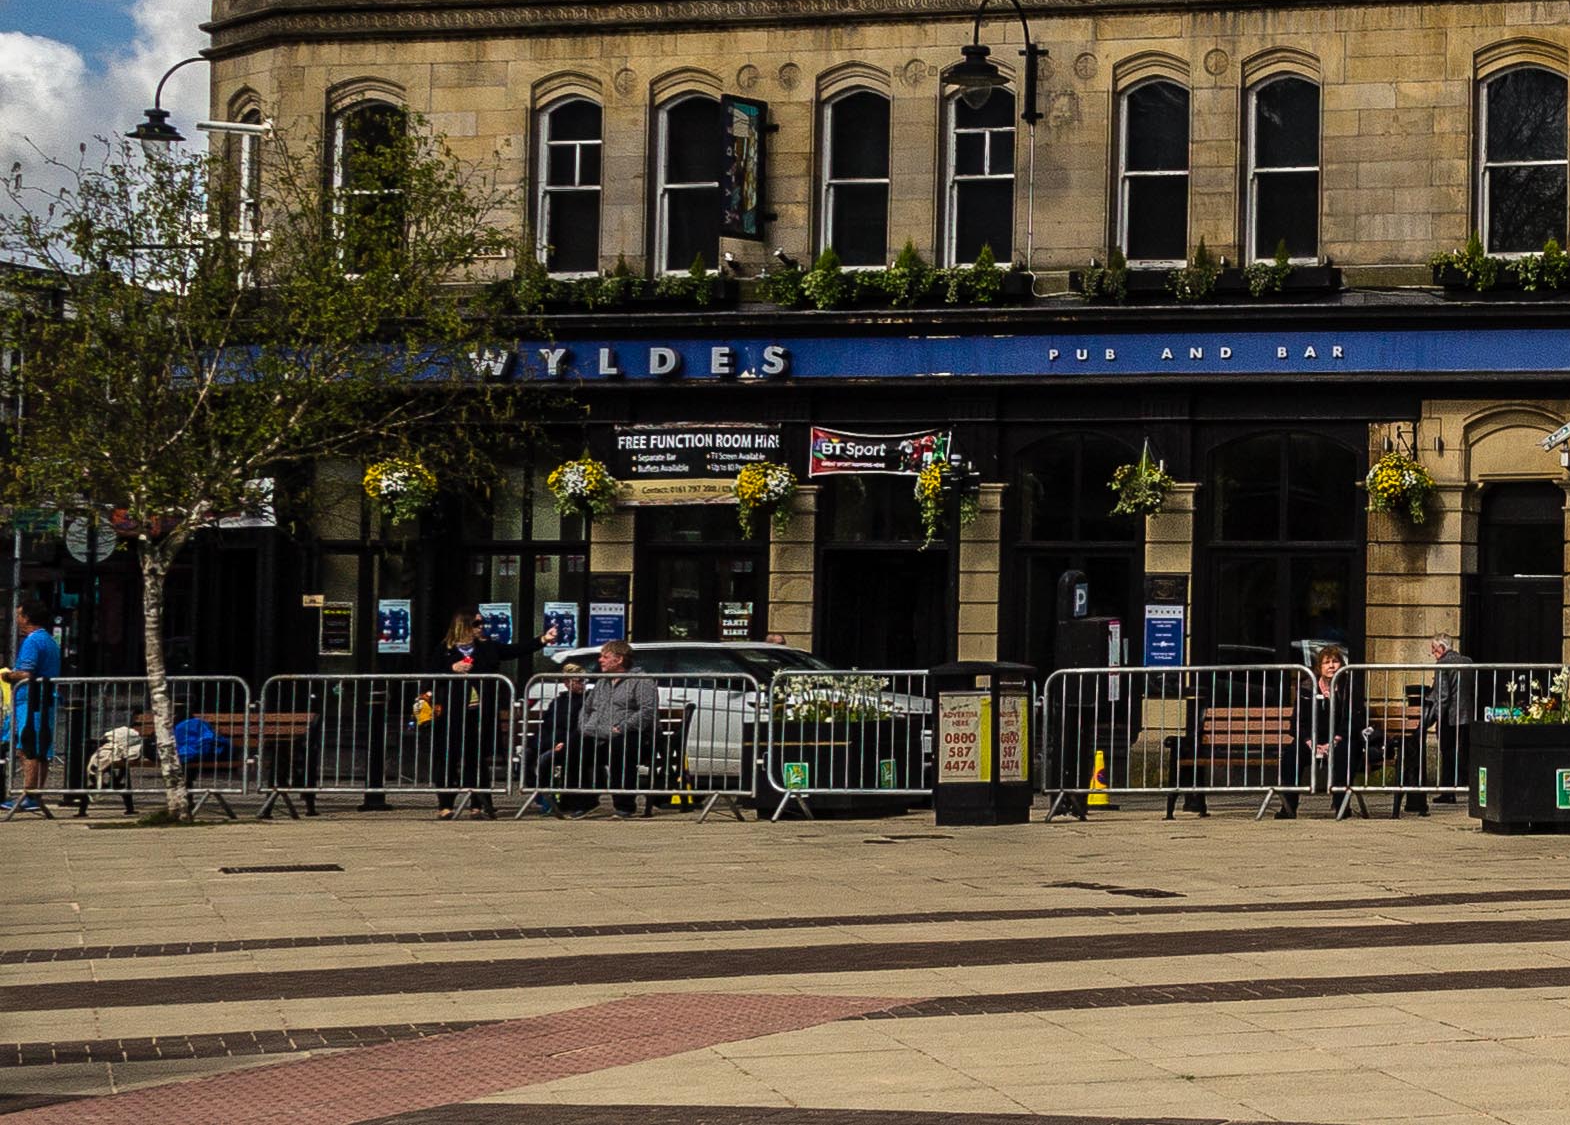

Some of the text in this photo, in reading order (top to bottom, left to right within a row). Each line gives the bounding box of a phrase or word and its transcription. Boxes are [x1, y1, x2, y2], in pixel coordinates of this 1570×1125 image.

[1048, 345, 1344, 361] PUB AND BAR
[467, 345, 786, 376] WYLDES
[617, 435, 647, 450] FREE
[650, 434, 713, 449] FUNCTION
[716, 433, 752, 449] ROOM
[821, 441, 887, 459] BT Sport
[1074, 588, 1087, 613] P
[944, 732, 977, 745] 0800
[948, 746, 973, 759] 587
[1003, 745, 1017, 758] 587
[943, 759, 977, 772] 4474
[1000, 759, 1020, 772] 4474
